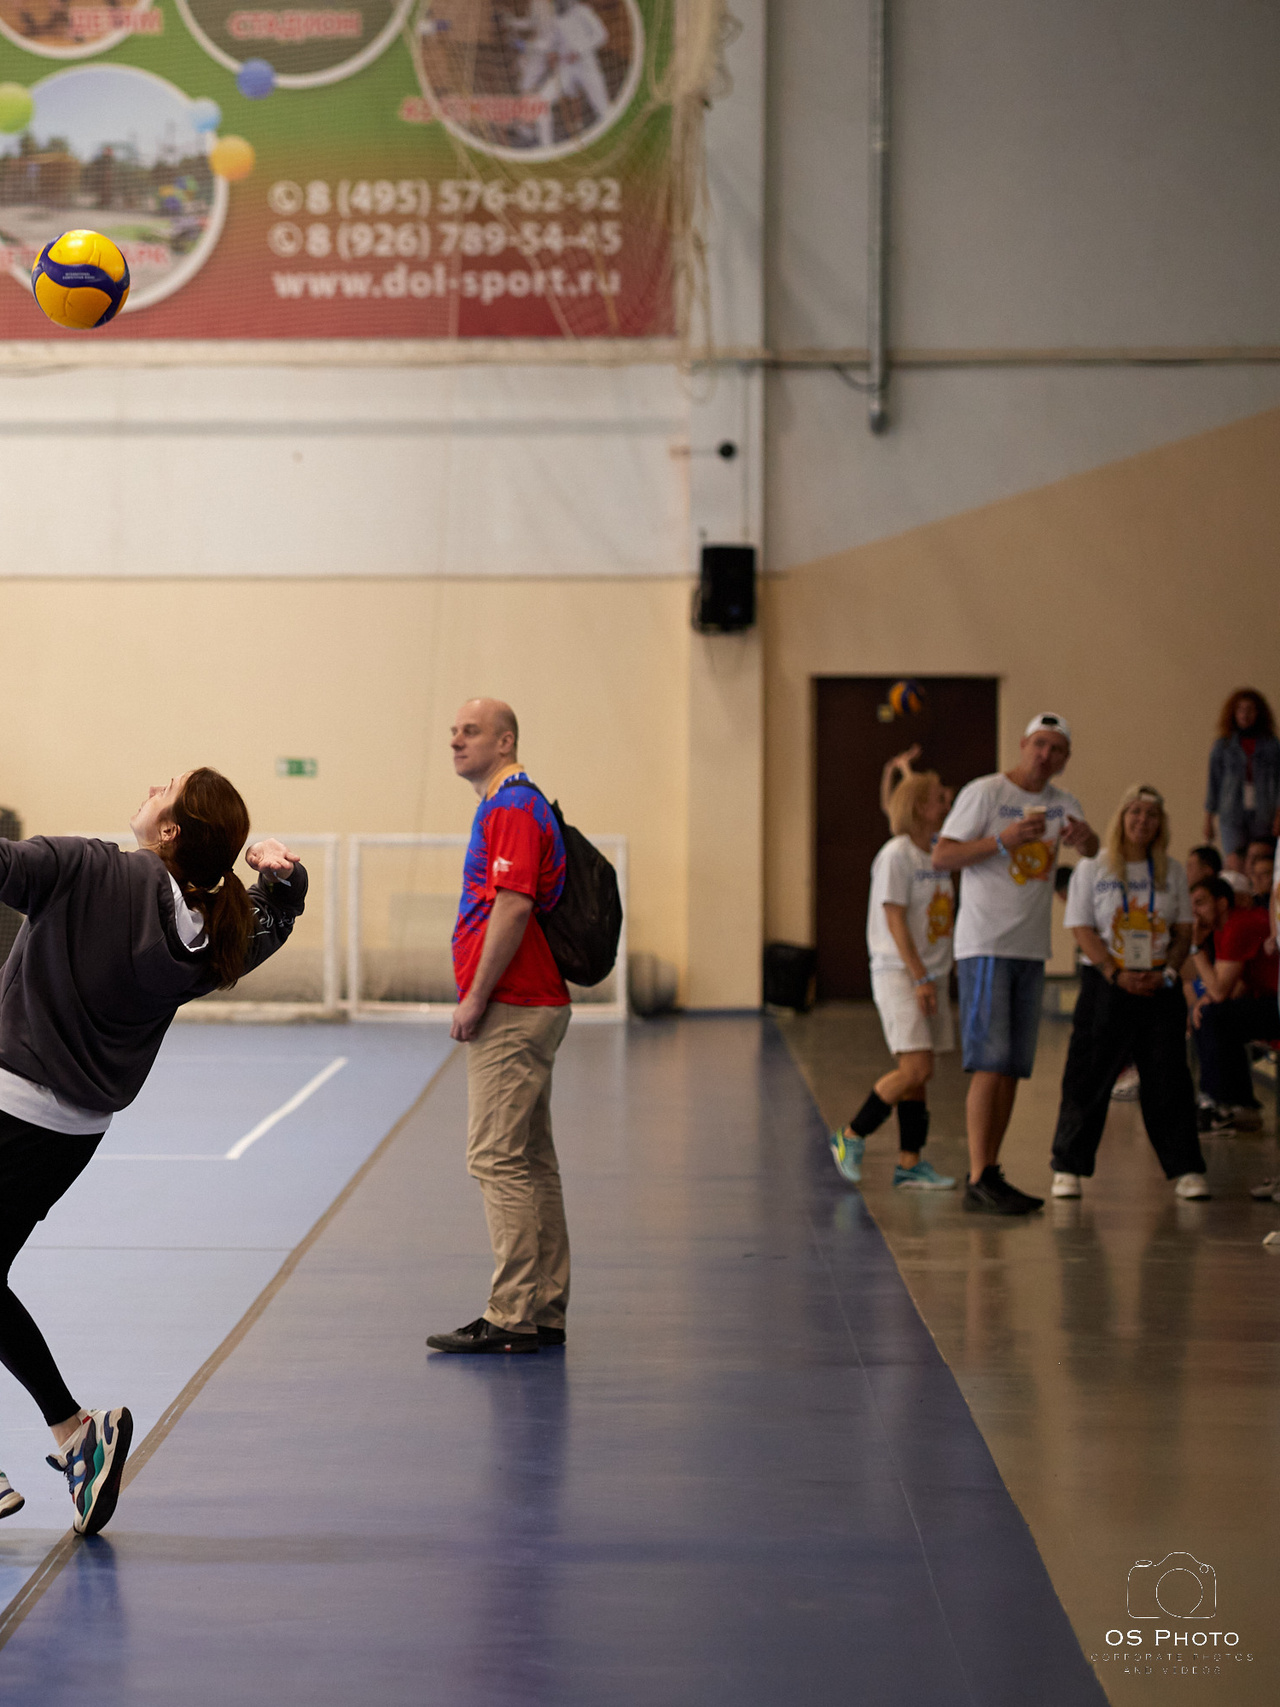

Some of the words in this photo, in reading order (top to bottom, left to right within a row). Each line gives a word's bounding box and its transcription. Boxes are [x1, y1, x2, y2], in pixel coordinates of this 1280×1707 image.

[226, 9, 363, 41] СТАДИОН
[305, 179, 331, 215] 8
[337, 178, 431, 219] (495)
[437, 177, 621, 214] 576-02-92
[305, 222, 331, 258] 8
[337, 221, 431, 261] (926)
[437, 220, 622, 256] 789-54-45
[273, 262, 621, 305] www.dol-sport.ru
